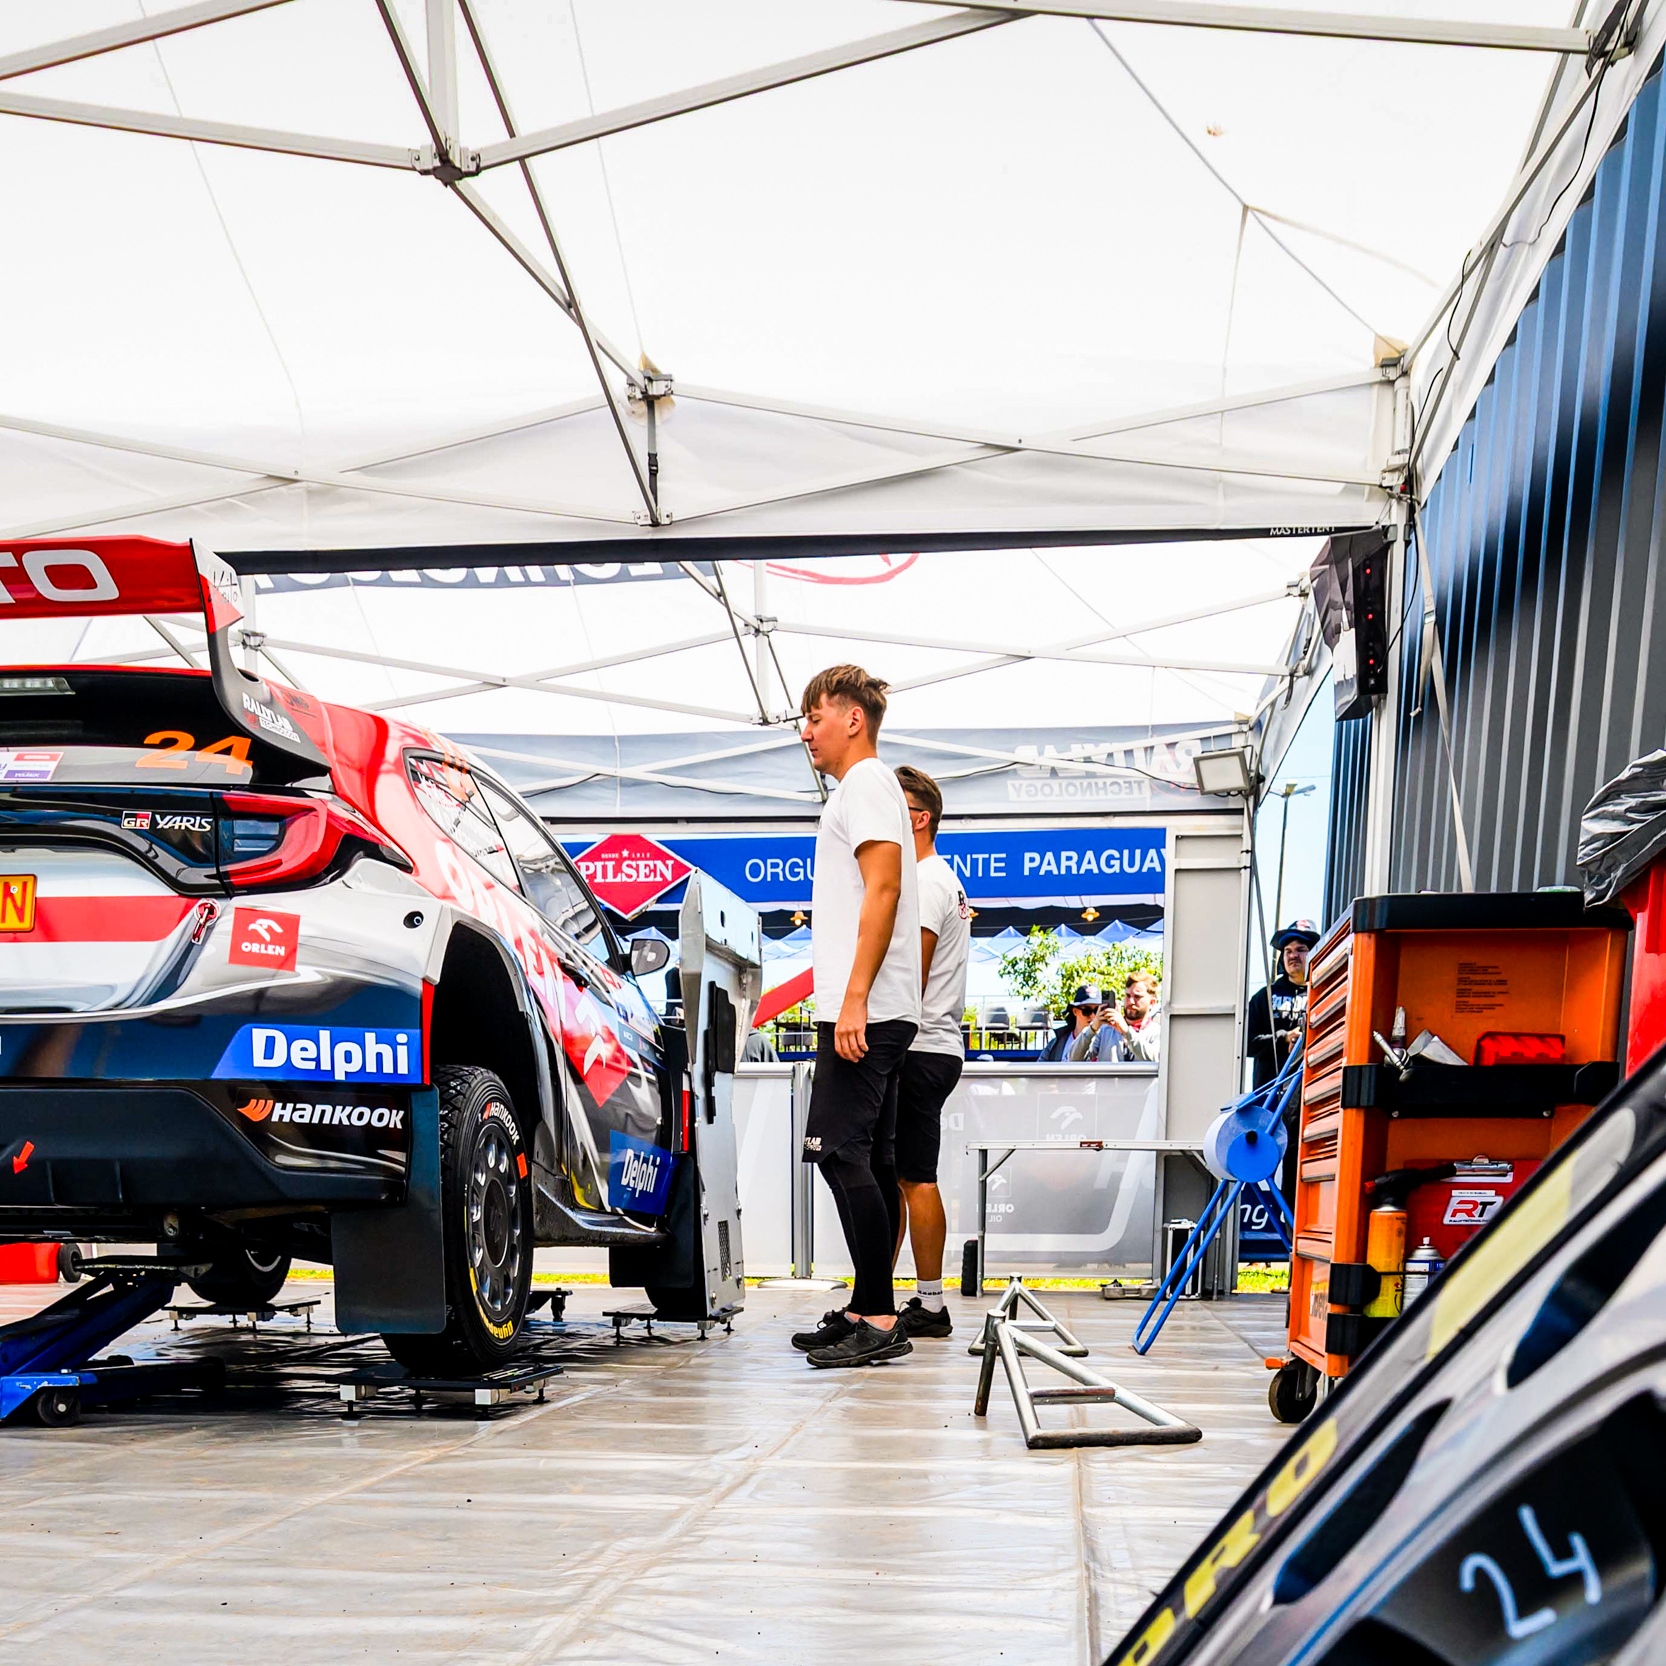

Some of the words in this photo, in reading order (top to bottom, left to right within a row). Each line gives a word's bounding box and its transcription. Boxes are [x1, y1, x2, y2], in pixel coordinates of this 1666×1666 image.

[1269, 526, 1335, 536] MASTERTENT
[135, 730, 254, 775] 24
[123, 817, 149, 828] GR
[154, 813, 214, 832] YARIS
[577, 859, 675, 884] PILSEN
[241, 941, 285, 956] ORLEN
[251, 1027, 409, 1081] Delphi
[621, 1148, 661, 1198] Delphi
[1450, 1200, 1497, 1218] RT
[1459, 1503, 1602, 1640] 24
